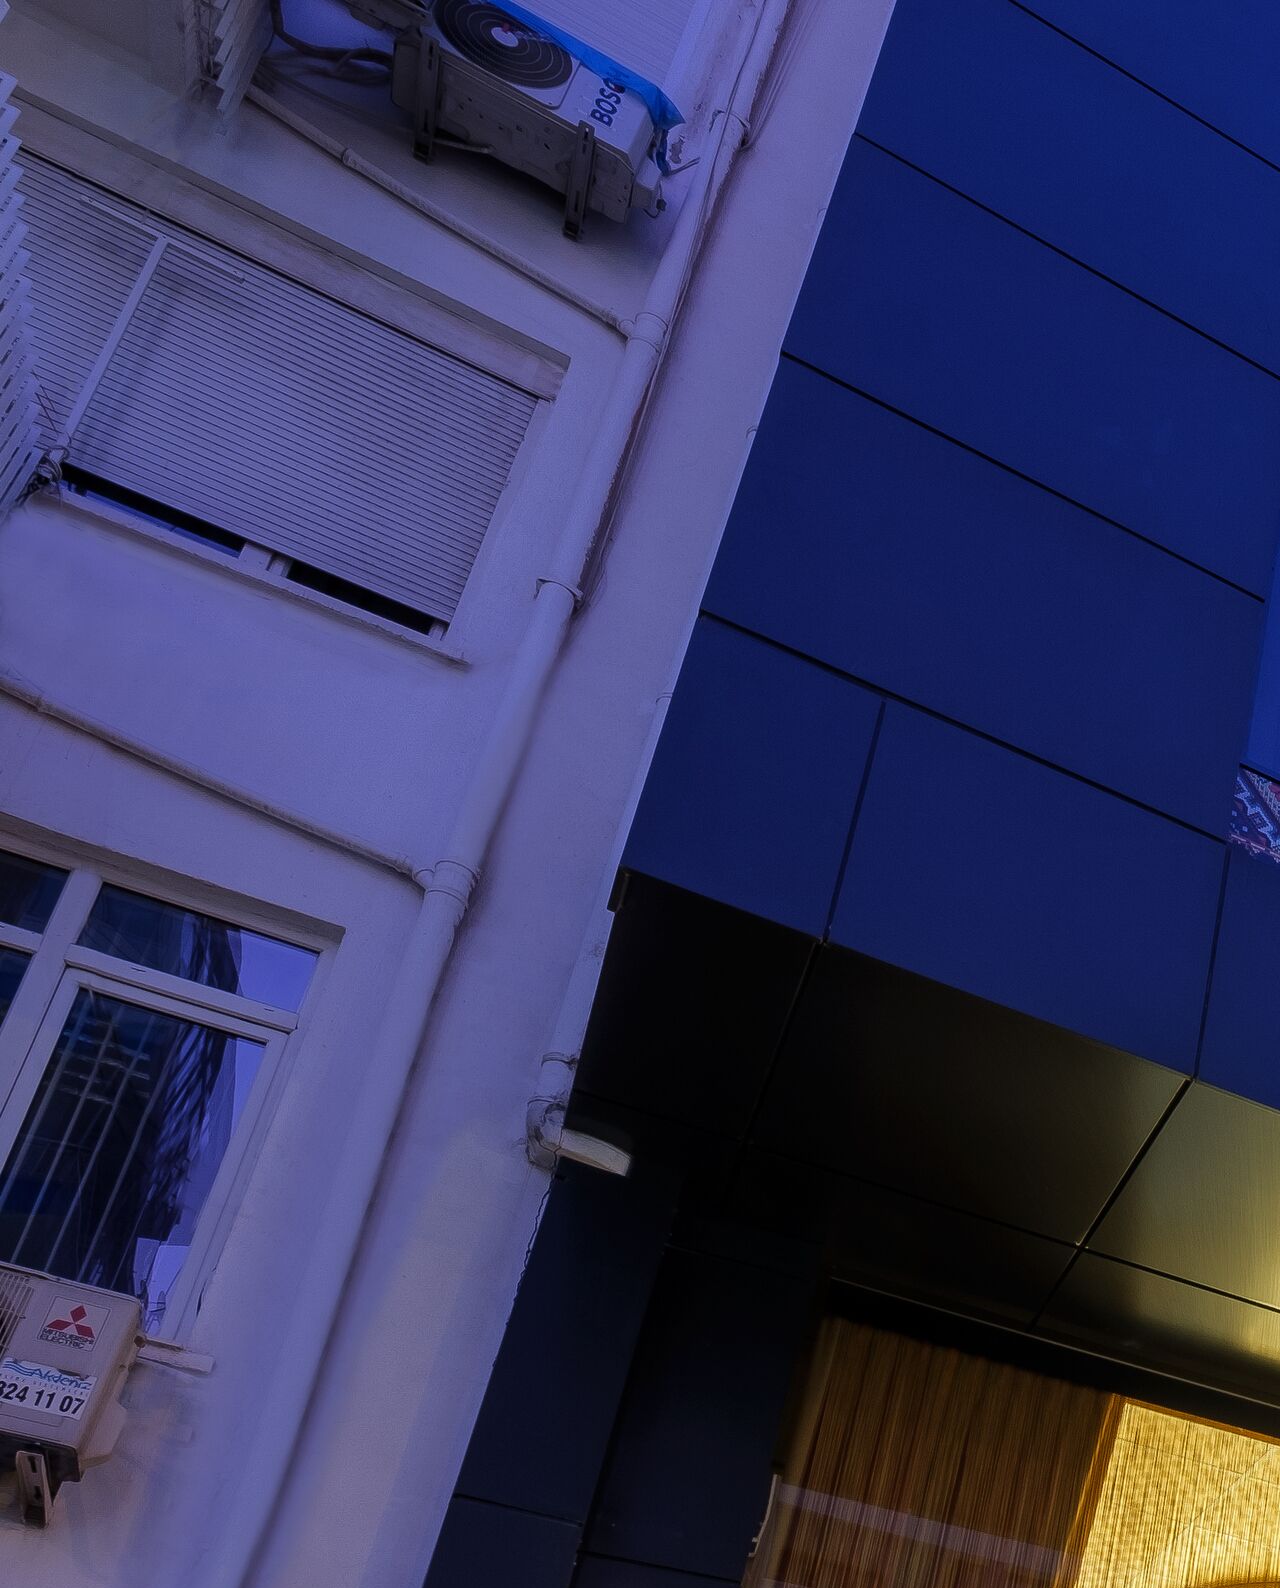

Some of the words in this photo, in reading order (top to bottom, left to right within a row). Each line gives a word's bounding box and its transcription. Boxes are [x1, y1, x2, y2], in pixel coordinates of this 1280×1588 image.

[39, 1335, 86, 1349] ELECTRIC
[34, 1389, 56, 1409] 11
[59, 1395, 85, 1415] 07
